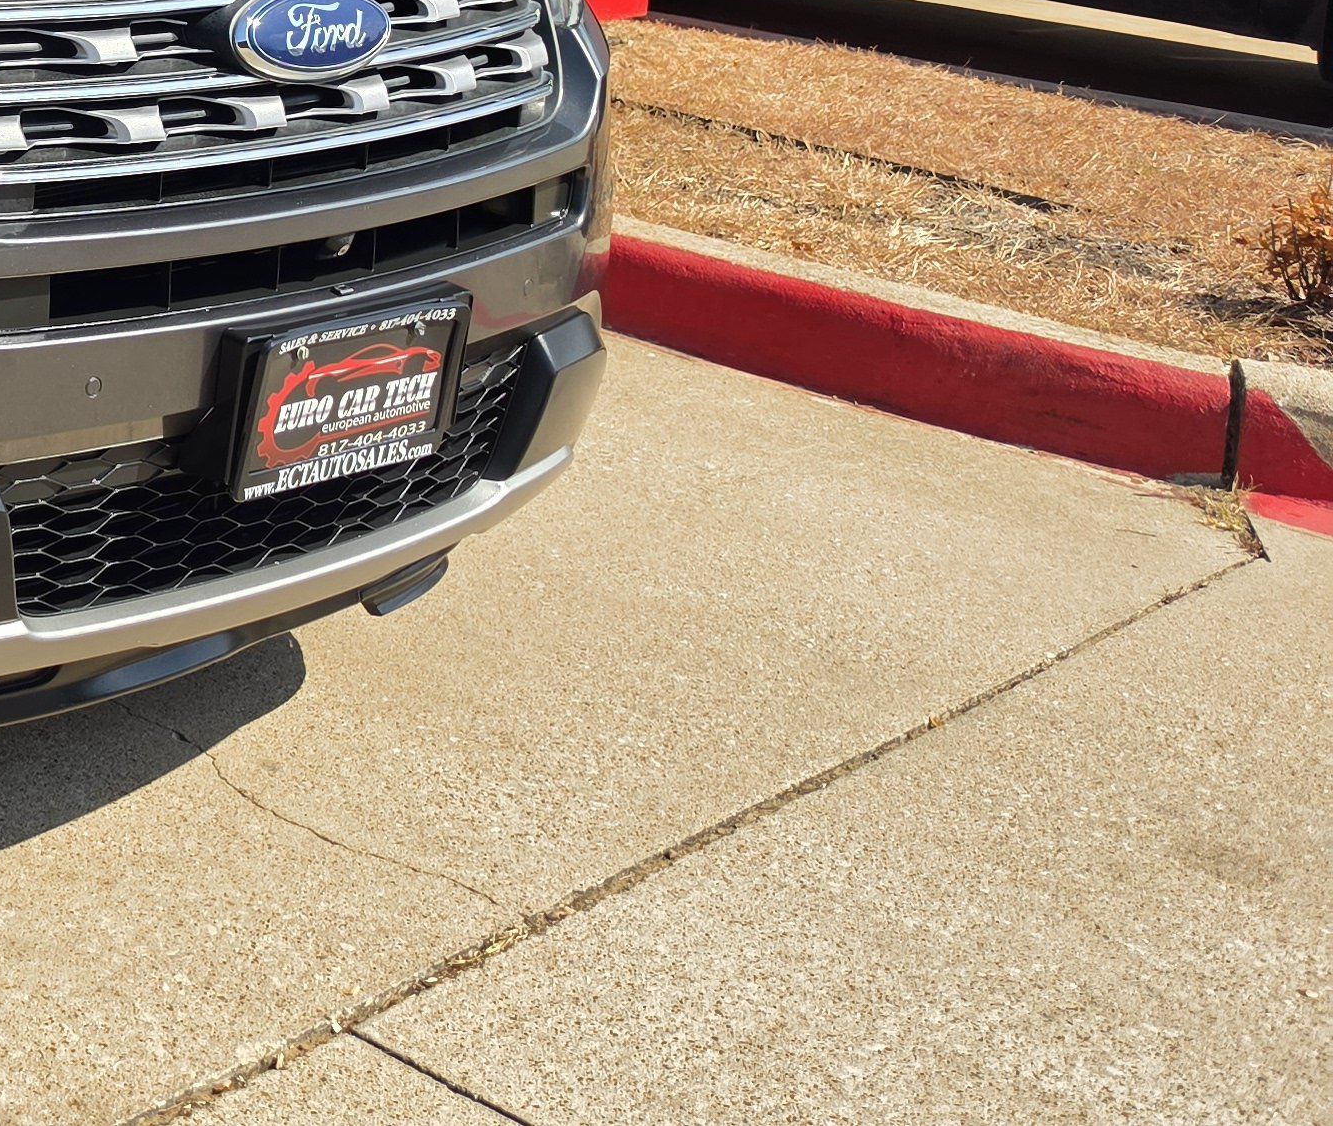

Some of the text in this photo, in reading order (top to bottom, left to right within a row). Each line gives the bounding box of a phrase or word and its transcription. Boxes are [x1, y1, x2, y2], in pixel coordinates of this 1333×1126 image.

[287, 2, 366, 56] Ford
[279, 308, 457, 355] SALES & SERVICE 817-404-4033
[274, 372, 438, 434] EURO CAR TECH
[322, 400, 430, 434] european automotive
[318, 421, 426, 456] 817-404-4033
[244, 439, 432, 500] www.ECTAUTOSALES.com
